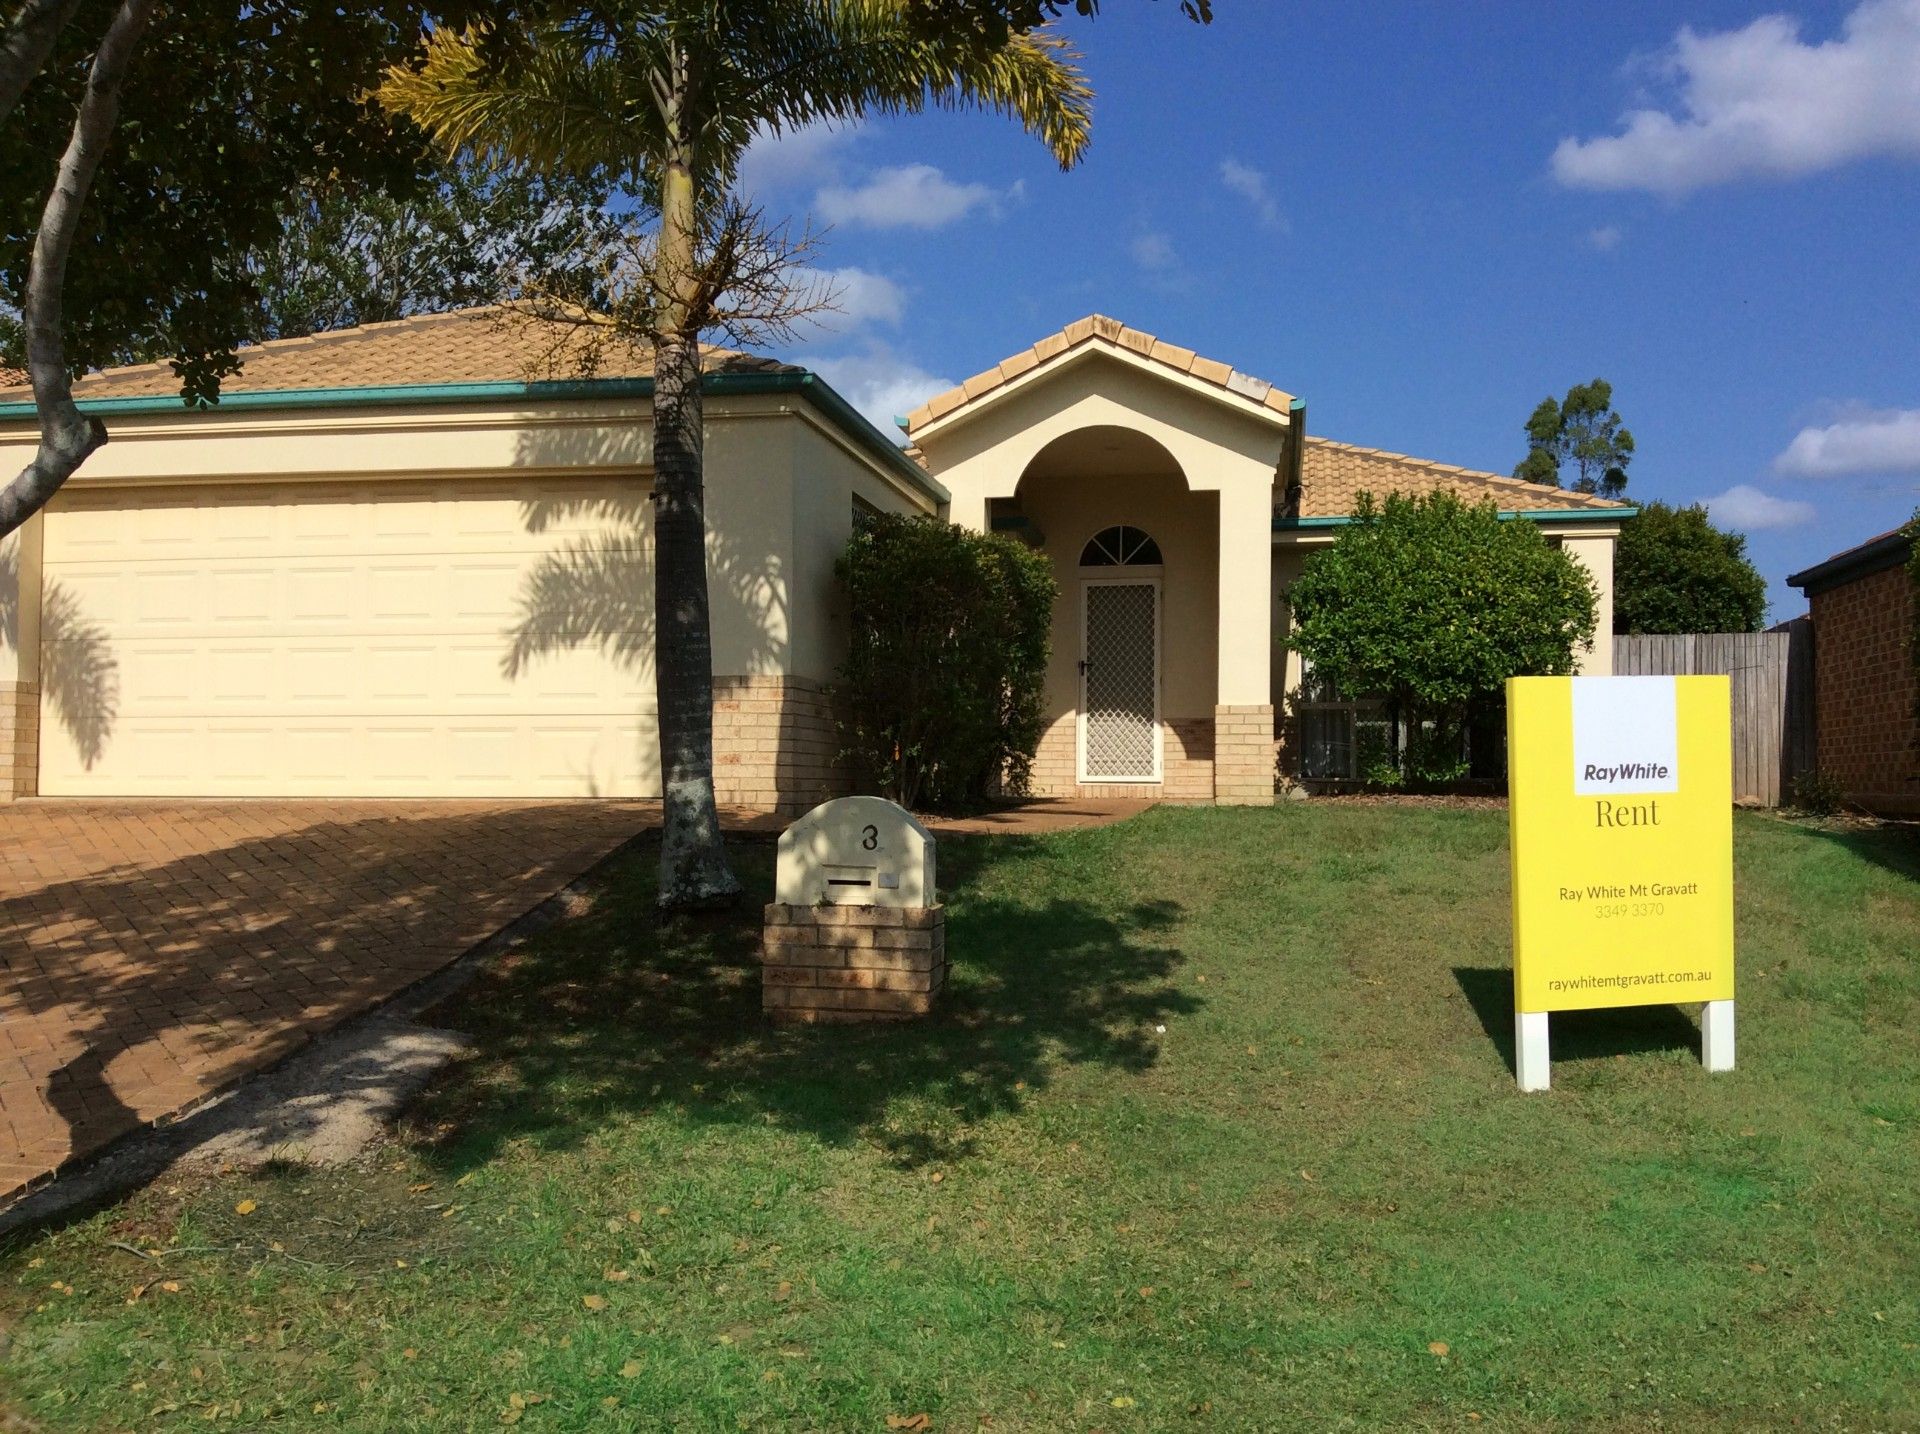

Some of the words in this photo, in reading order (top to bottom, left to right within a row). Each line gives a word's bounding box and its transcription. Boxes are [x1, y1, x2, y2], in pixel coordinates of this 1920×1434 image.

[1595, 800, 1662, 828] Rent
[862, 824, 879, 850] 3
[1559, 887, 1583, 903] Ray
[1586, 885, 1626, 899] White
[1629, 884, 1648, 897] Mt
[1651, 882, 1698, 897] Gravatt
[1595, 904, 1628, 919] 3349
[1631, 902, 1664, 917] 3370
[1549, 970, 1712, 993] raywhitemtgravatt.com.au
